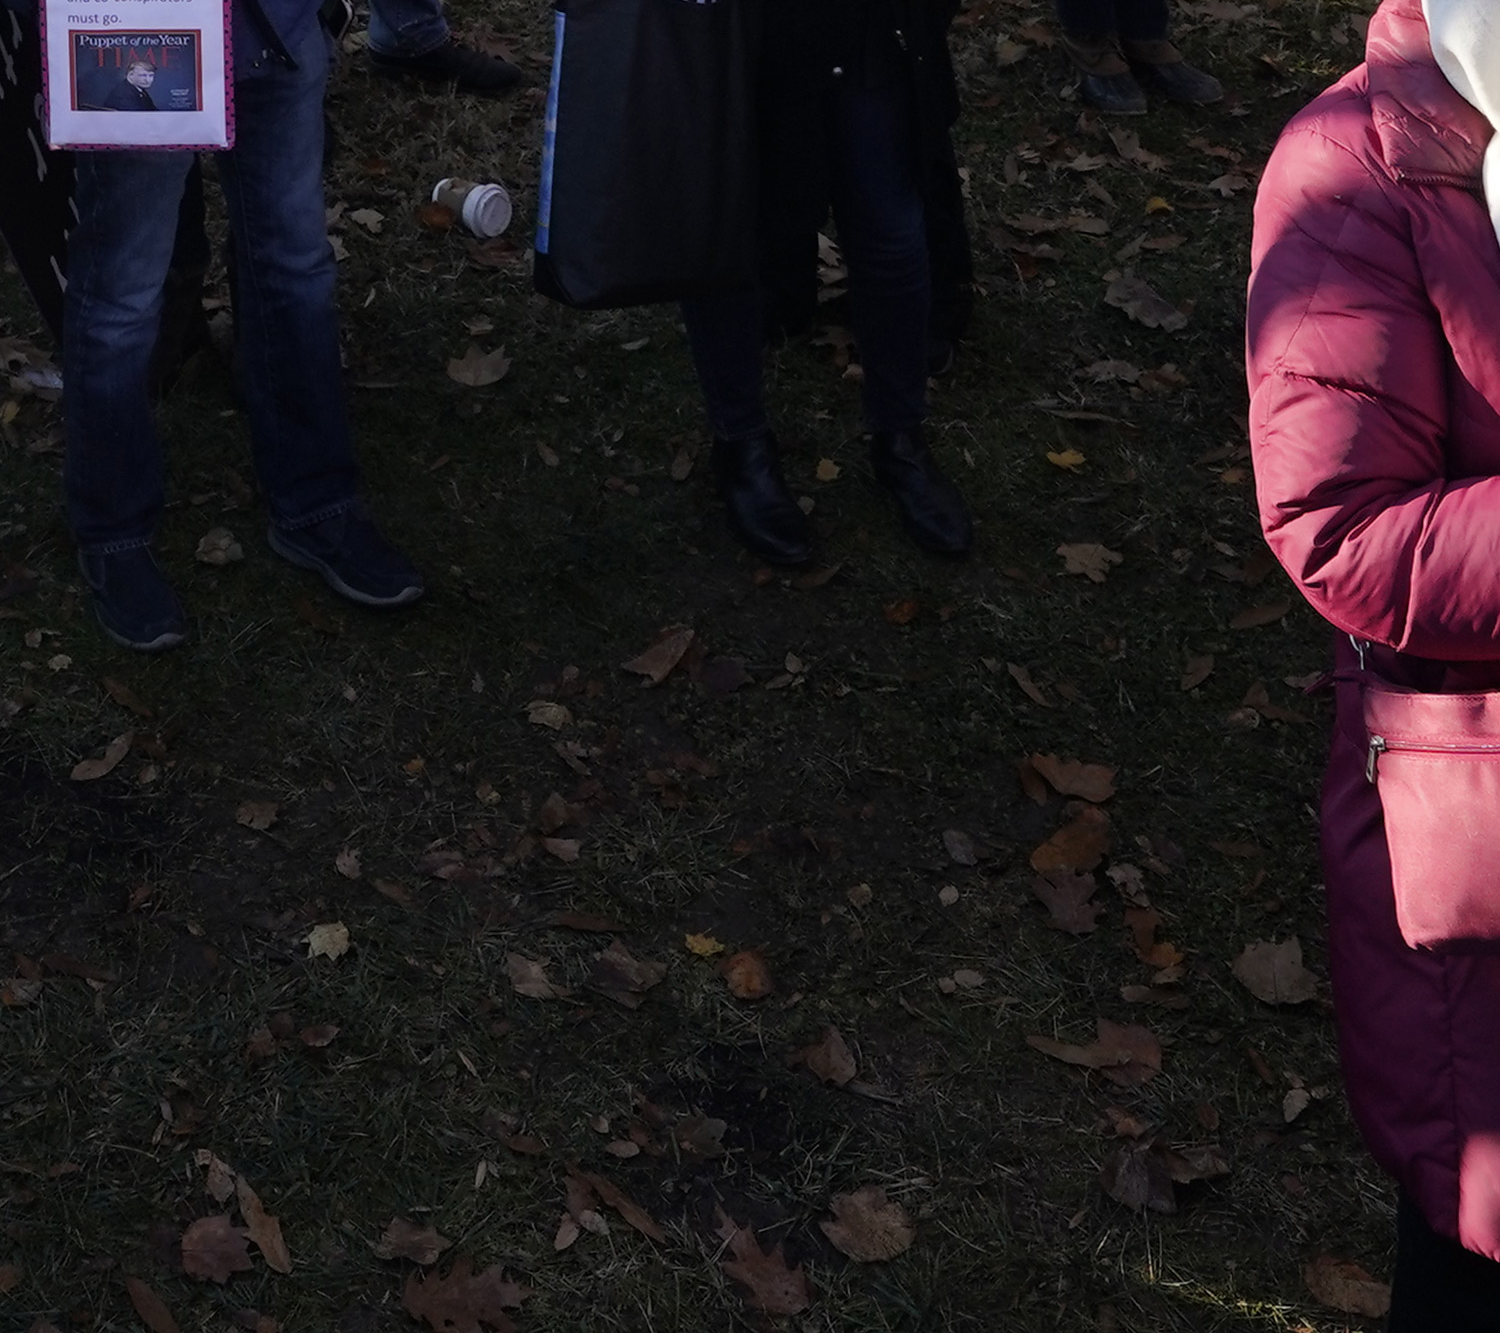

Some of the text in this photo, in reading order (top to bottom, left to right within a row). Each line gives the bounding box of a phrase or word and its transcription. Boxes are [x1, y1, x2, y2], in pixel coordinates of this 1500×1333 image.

[68, 13, 122, 27] must go.
[79, 35, 127, 48] Puppet
[129, 35, 141, 48] of
[159, 34, 190, 47] Year
[88, 46, 182, 68] TIME
